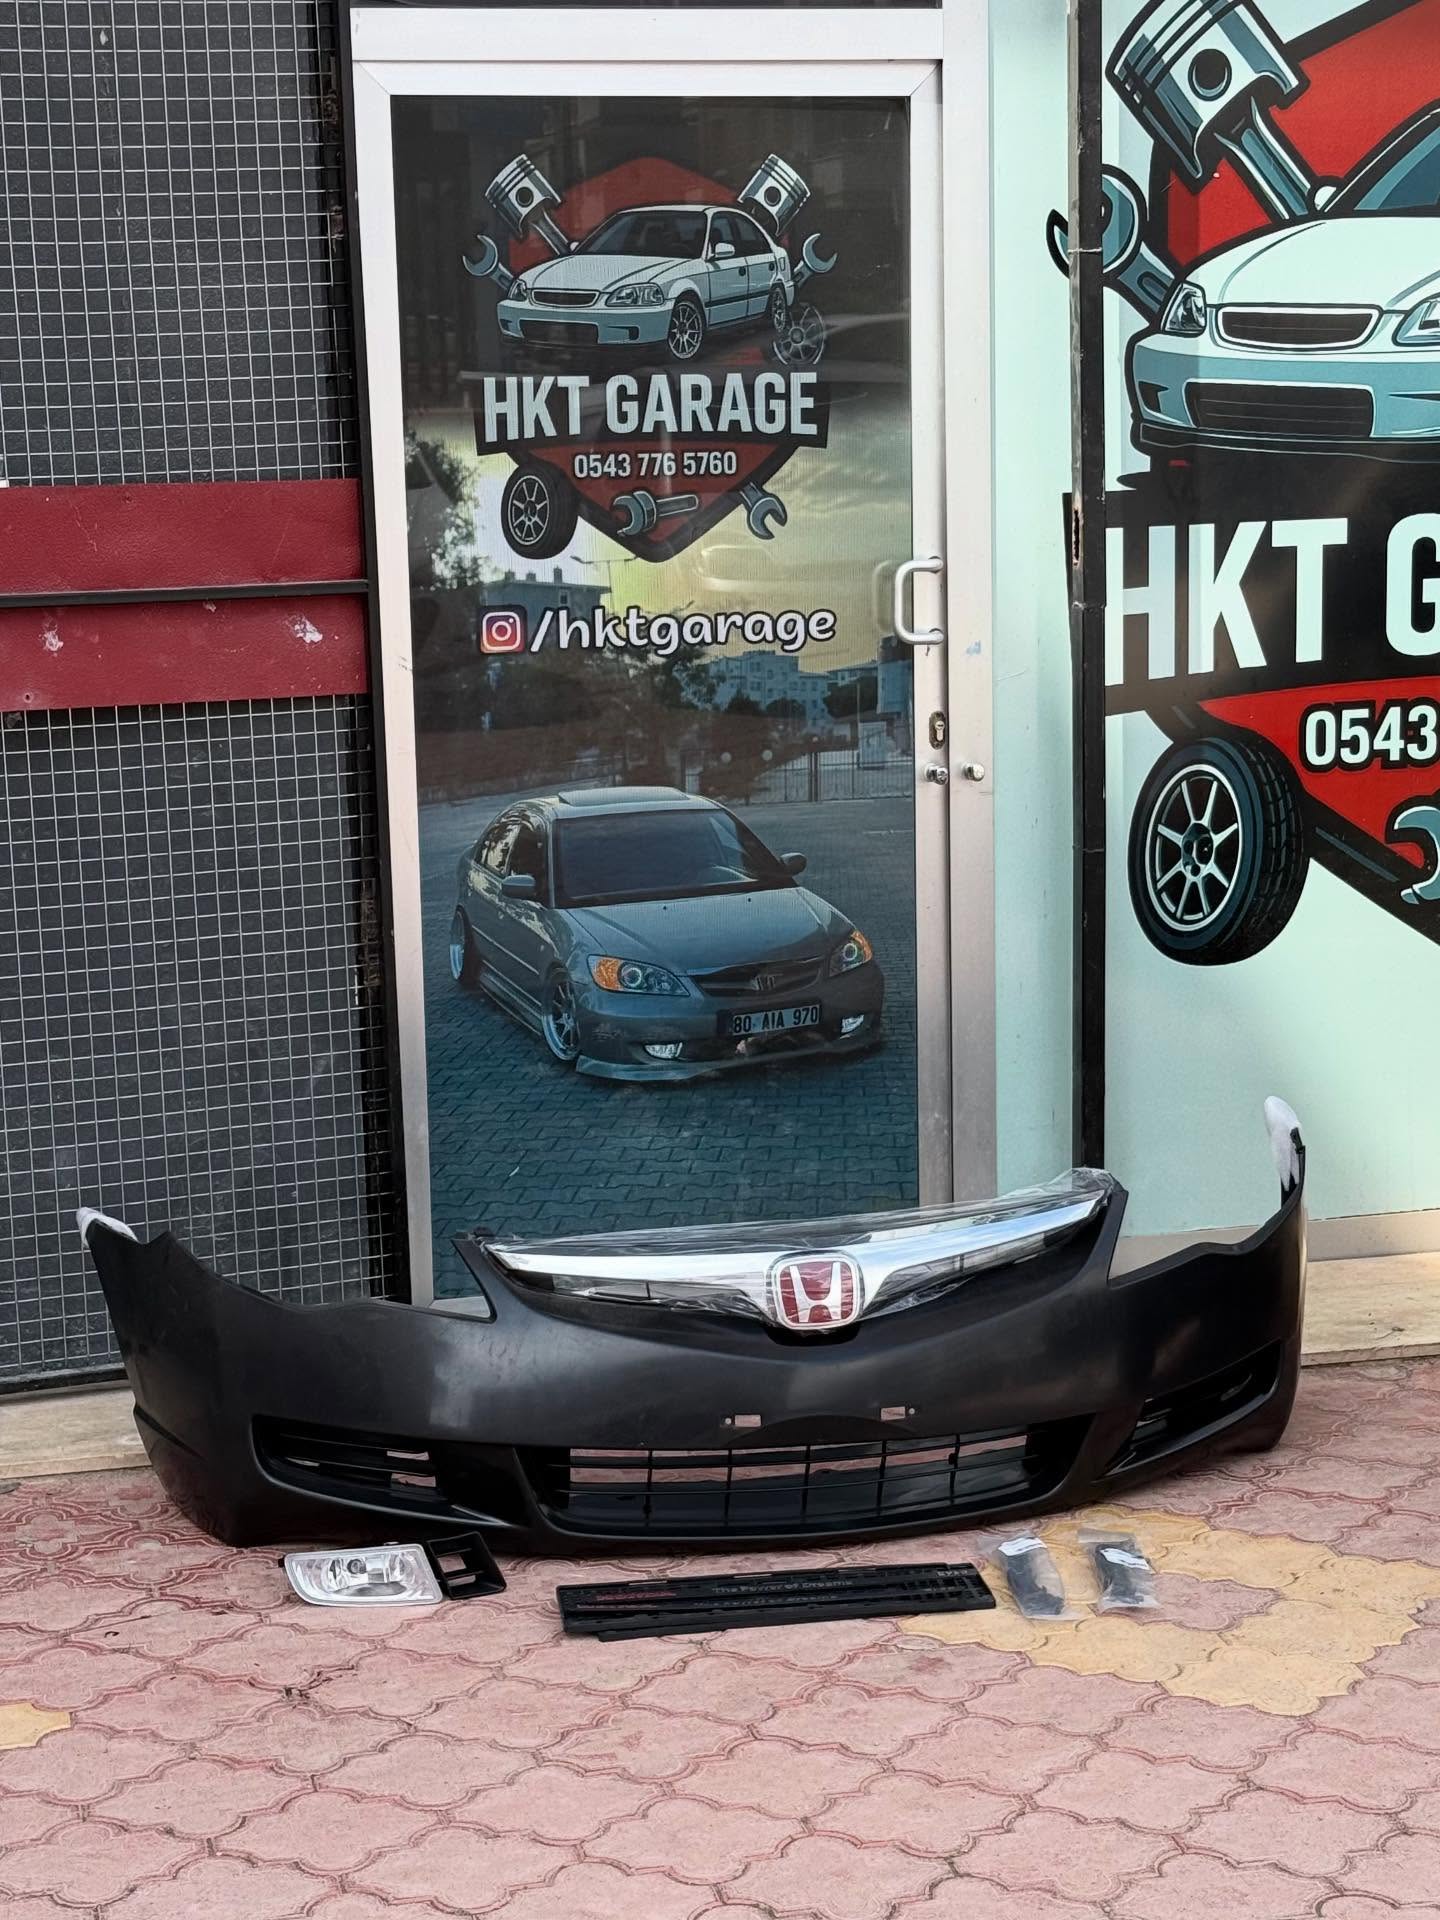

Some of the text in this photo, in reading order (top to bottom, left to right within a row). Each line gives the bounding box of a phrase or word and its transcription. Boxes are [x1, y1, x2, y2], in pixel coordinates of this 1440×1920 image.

[483, 371, 818, 443] HKT GARAGE
[574, 450, 737, 478] 0543 776 5760
[1104, 517, 1349, 686] HKT
[1304, 704, 1438, 766] 0543
[733, 1006, 818, 1034] 80 AIA 970
